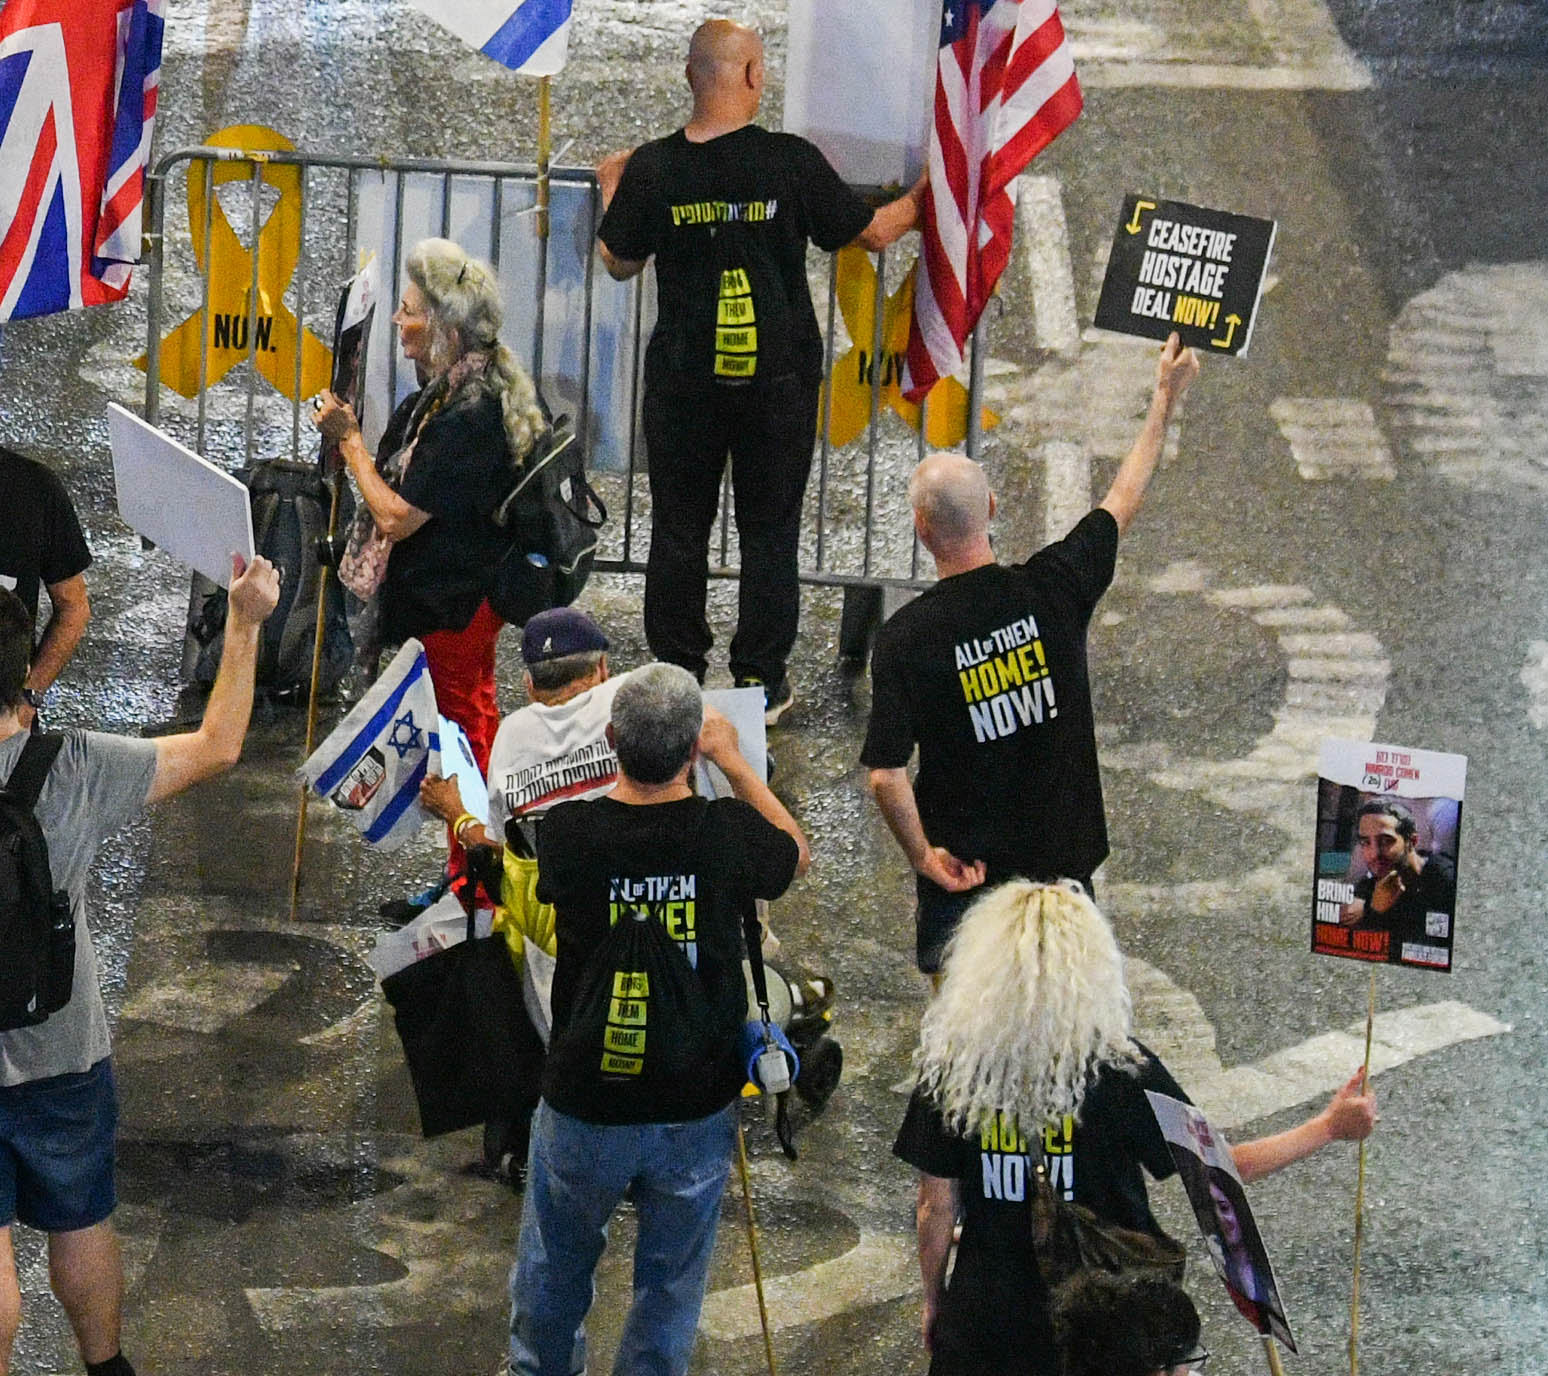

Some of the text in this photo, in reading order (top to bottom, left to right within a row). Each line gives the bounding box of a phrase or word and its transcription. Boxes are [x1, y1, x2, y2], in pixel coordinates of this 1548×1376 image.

[1148, 219, 1237, 262] CEASEFIRE
[1138, 250, 1230, 298] HOSTAGE
[1131, 286, 1221, 330] DEAL NOW!
[955, 638, 989, 671] ALL
[990, 615, 1040, 654] THEM
[959, 640, 1049, 703] HOME!
[968, 677, 1058, 743] NOW!
[1316, 901, 1340, 924] HIM
[1318, 878, 1354, 903] BRING
